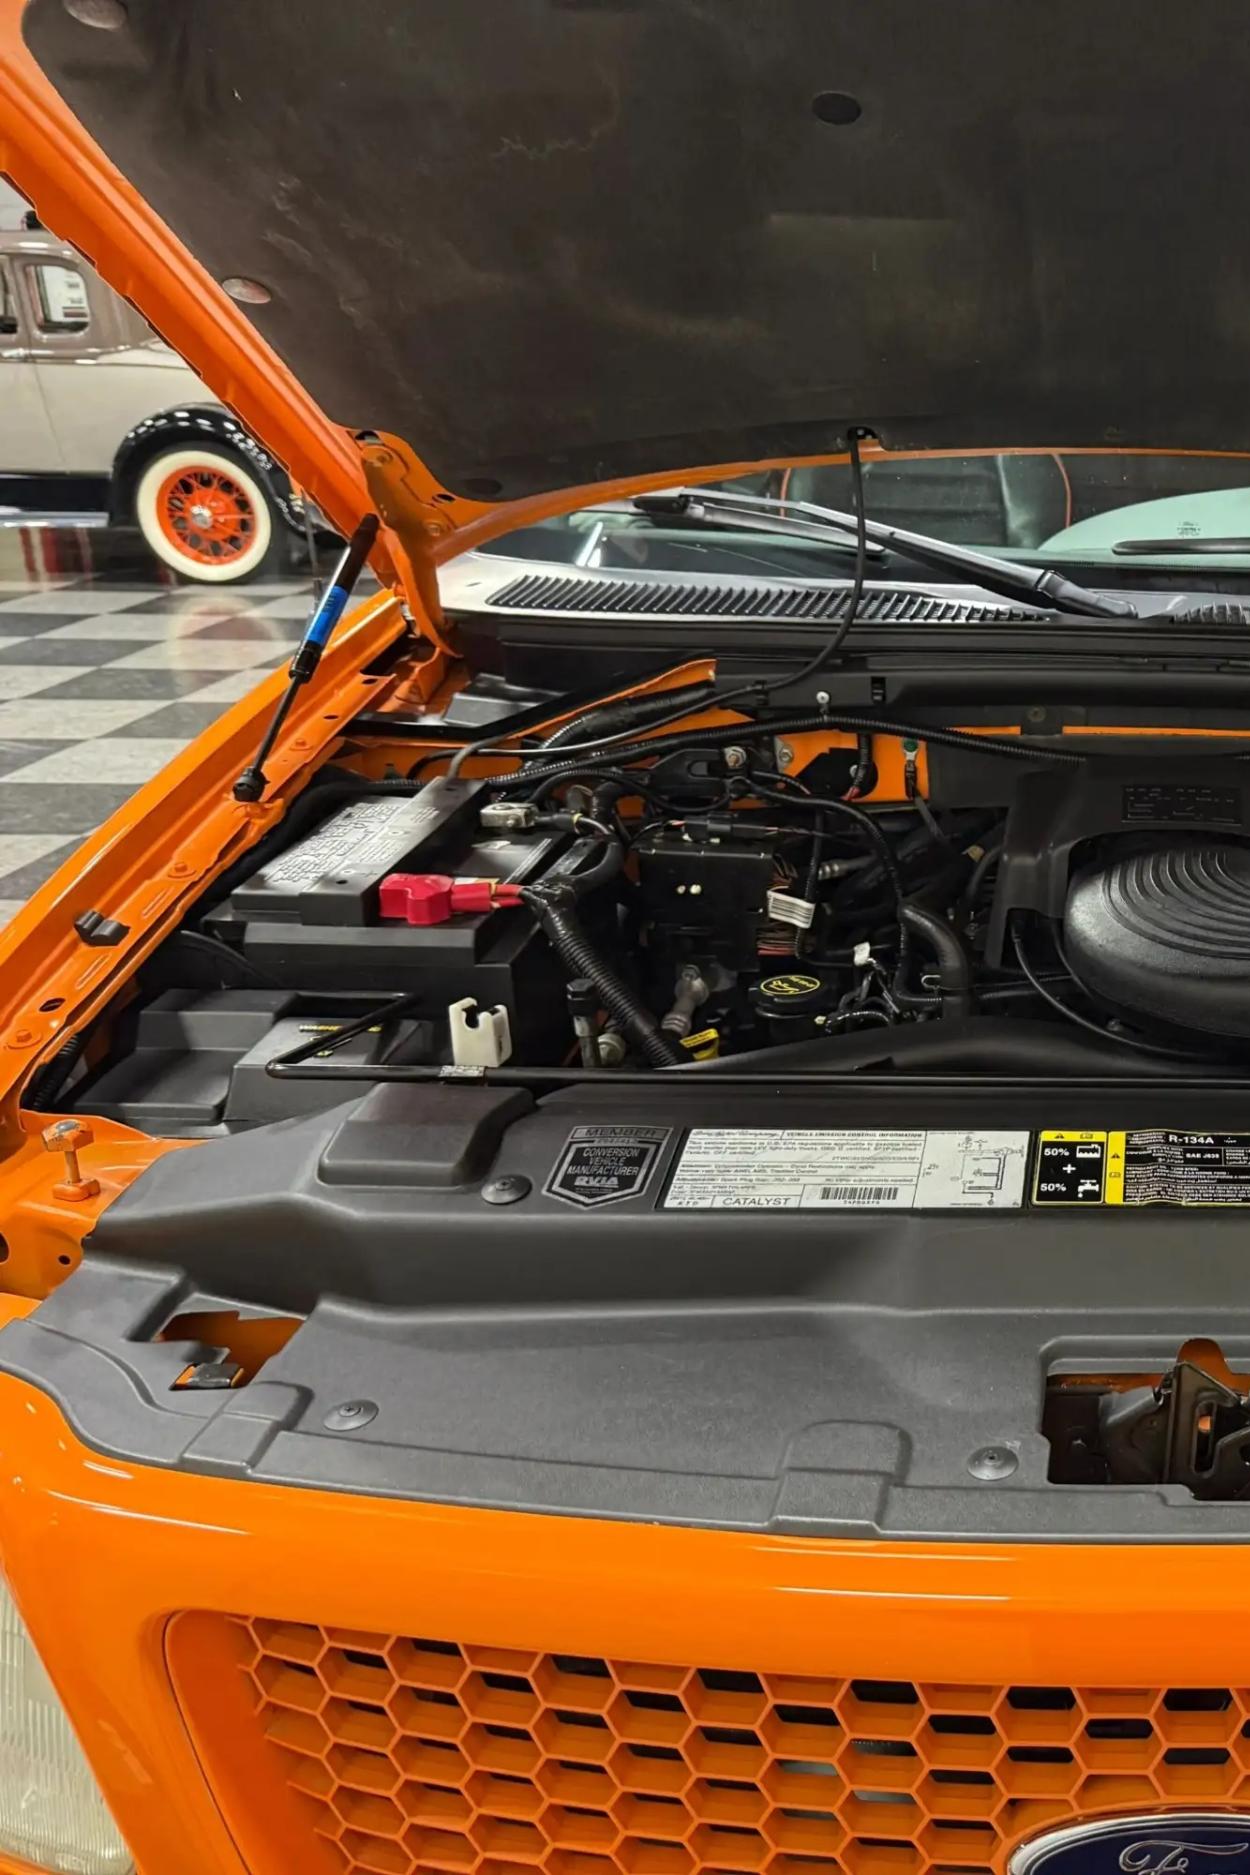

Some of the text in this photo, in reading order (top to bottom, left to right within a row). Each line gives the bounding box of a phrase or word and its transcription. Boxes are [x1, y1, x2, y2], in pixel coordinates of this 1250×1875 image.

[585, 1127, 657, 1137] MEMBER
[1168, 1134, 1214, 1144] R-134A
[582, 1148, 640, 1157] CONVERSION
[1043, 1147, 1070, 1156] 50%
[588, 1156, 626, 1166] VEHICLE
[567, 1166, 640, 1176] MANUFACTURER
[1040, 1182, 1067, 1192] 50%
[722, 1197, 791, 1206] CATALYST
